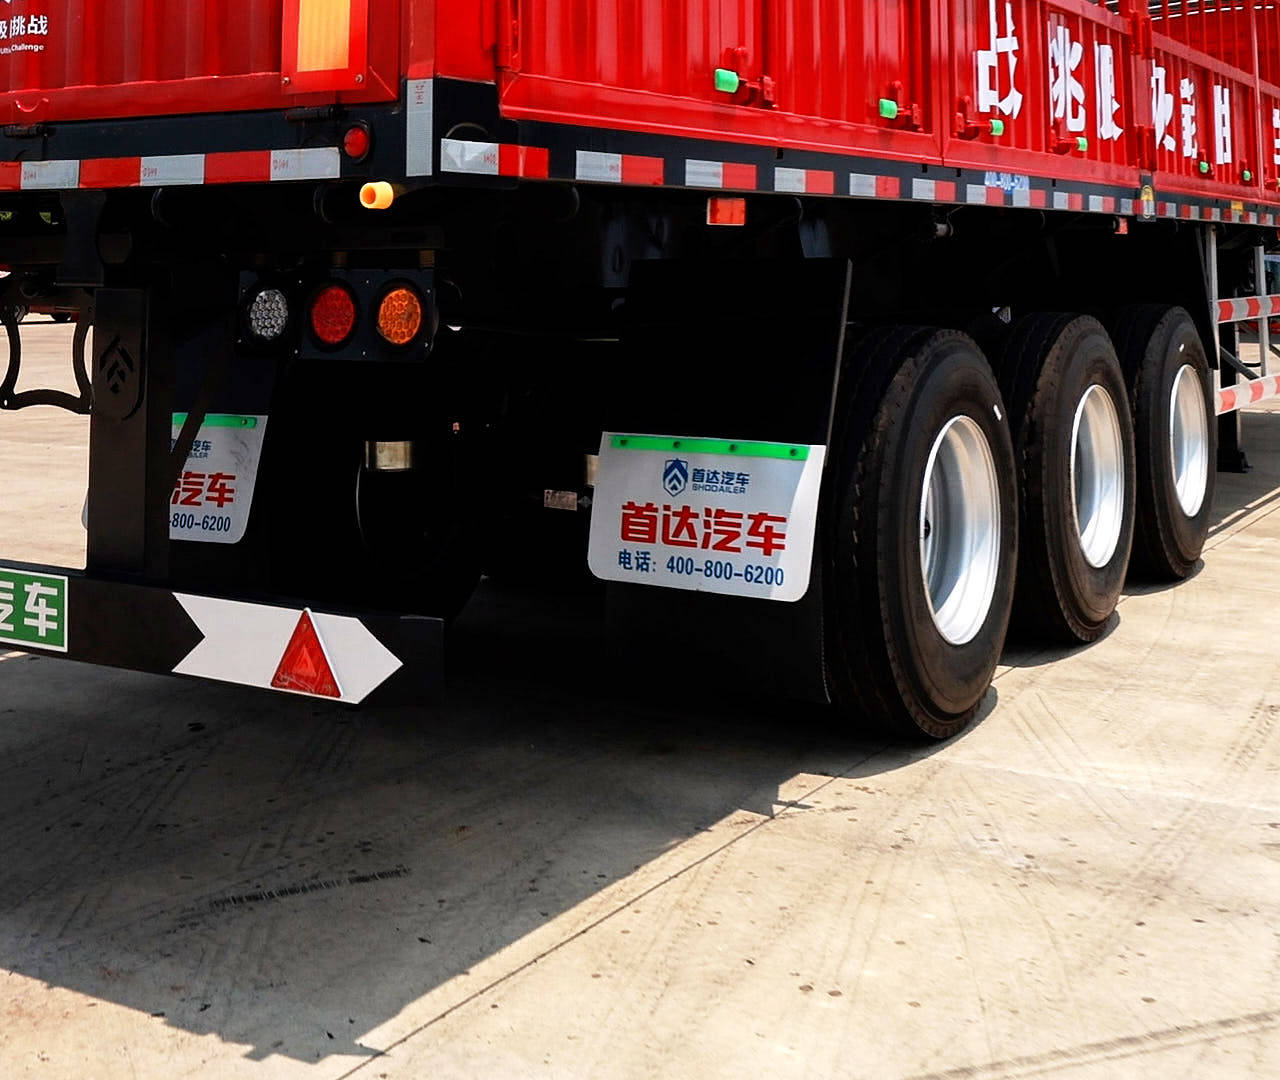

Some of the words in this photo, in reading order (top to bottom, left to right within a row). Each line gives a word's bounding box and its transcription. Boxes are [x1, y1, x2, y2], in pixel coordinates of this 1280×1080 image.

[692, 468, 749, 487] 首达汽车
[621, 501, 787, 557] 首达汽车
[666, 555, 785, 587] 400-800-6200
